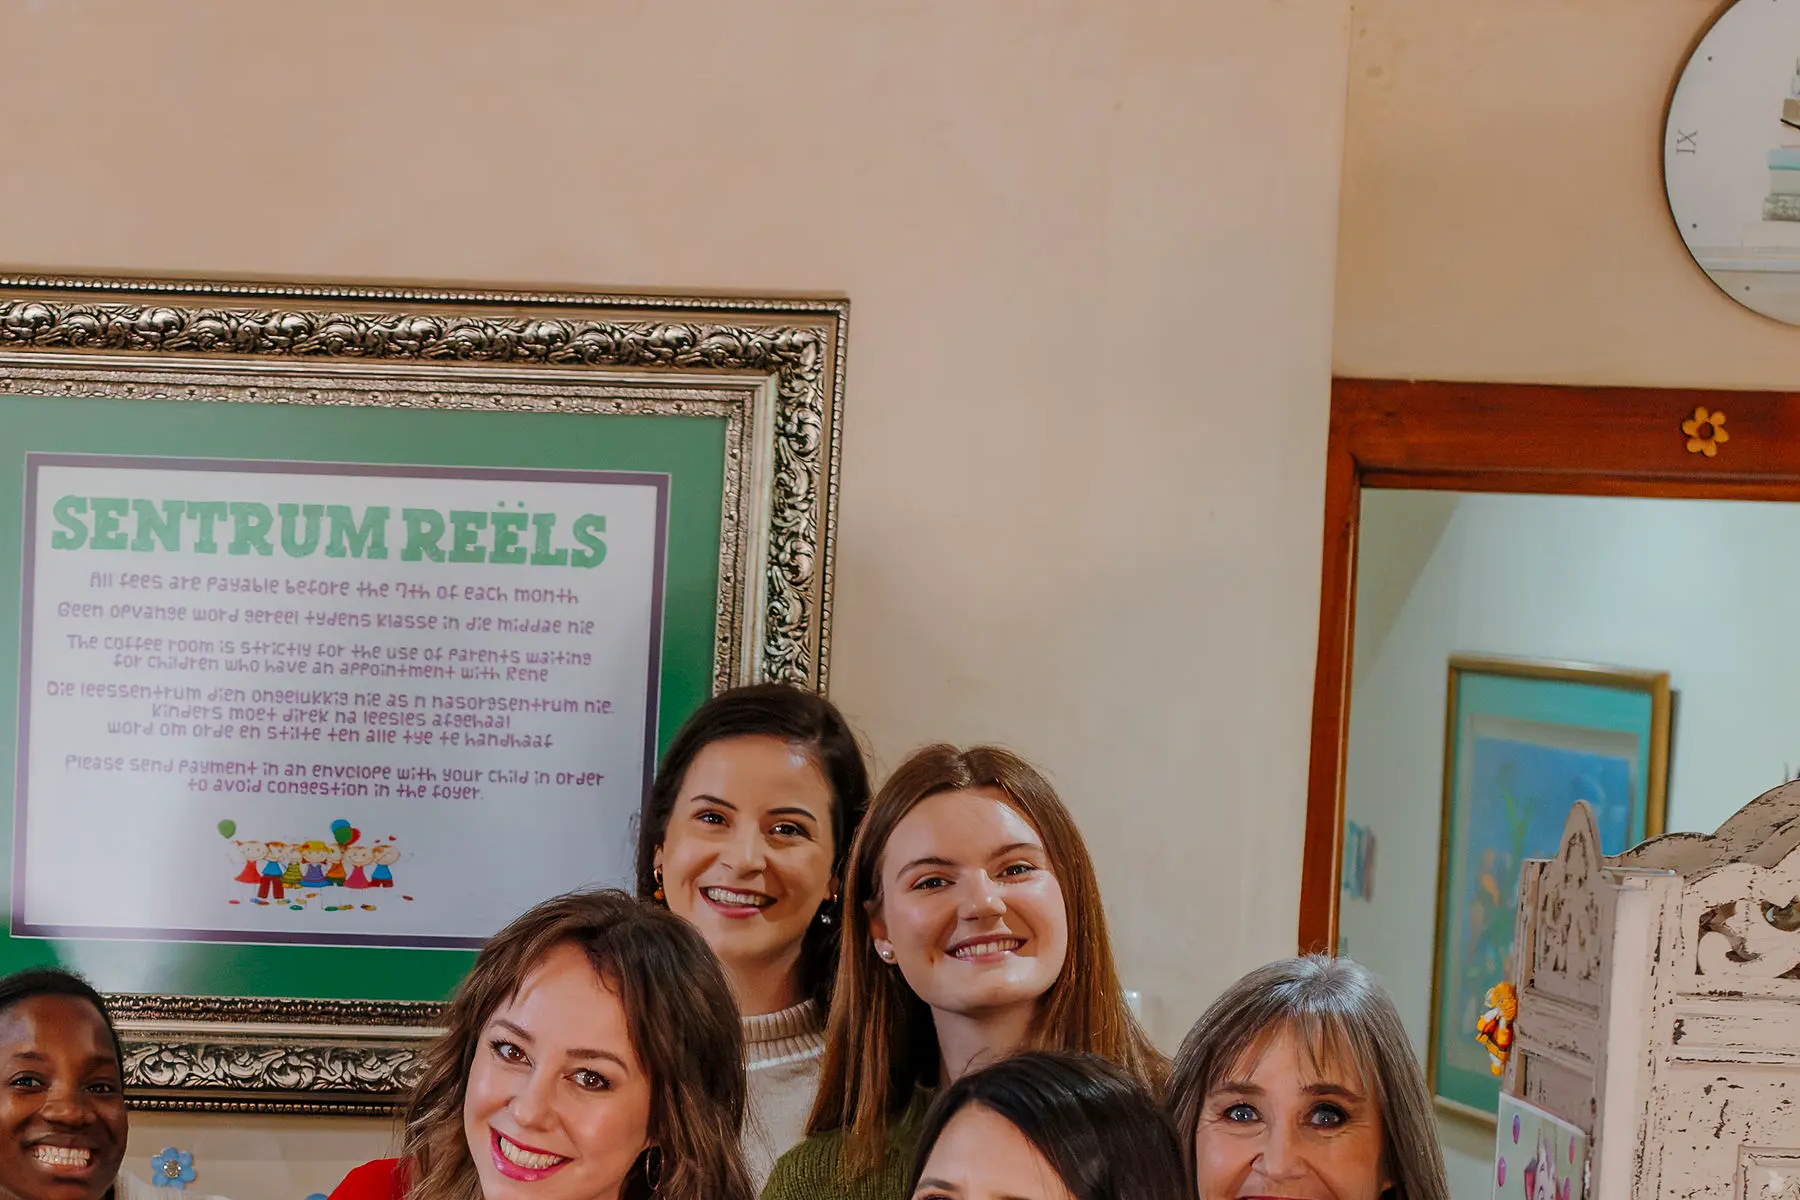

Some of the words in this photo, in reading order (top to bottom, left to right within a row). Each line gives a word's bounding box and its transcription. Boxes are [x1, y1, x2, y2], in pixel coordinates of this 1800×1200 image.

[51, 495, 390, 559] SENTRUM
[401, 500, 607, 569] REËLS
[90, 571, 112, 588] All
[119, 573, 162, 589] fees
[169, 576, 200, 590] are
[286, 579, 349, 596] before
[356, 581, 389, 597] the
[396, 582, 430, 599] 7th
[437, 585, 458, 599] of
[464, 585, 507, 601] each
[514, 587, 578, 604] month
[58, 602, 103, 618] Geen
[193, 607, 239, 622] word
[305, 610, 371, 627] tydens
[443, 615, 459, 630] in
[466, 615, 491, 631] die
[567, 619, 595, 635] nie
[66, 635, 98, 649] The
[104, 635, 162, 652] coffee
[169, 638, 214, 653] room
[220, 639, 234, 654] is
[241, 640, 311, 656] strictly
[316, 642, 344, 658] for
[351, 644, 381, 659] the
[387, 646, 418, 660] use
[424, 647, 442, 661] of
[526, 650, 591, 666] waiting
[113, 653, 141, 668] for
[225, 659, 259, 673] who
[264, 659, 307, 674] have
[312, 661, 334, 675] an
[461, 666, 500, 680] with
[47, 681, 75, 696] Die
[81, 682, 201, 700] leessentrum
[207, 687, 246, 702] dien
[355, 692, 381, 707] nie
[387, 694, 408, 708] as
[415, 695, 426, 709] n
[432, 695, 578, 713] nasorgsentrum
[229, 708, 277, 721] moet
[282, 709, 328, 724] direk
[335, 710, 356, 724] na
[363, 711, 426, 726] leesles
[432, 714, 510, 729] afgehaal
[108, 721, 153, 735] word
[160, 723, 186, 737] om
[193, 723, 233, 738] orde
[240, 725, 260, 739] en
[267, 726, 321, 741] stilte
[327, 728, 359, 742] ten
[366, 729, 397, 744] alle
[403, 730, 433, 745] tye
[439, 731, 459, 746] te
[465, 733, 554, 748] handhaaf
[66, 754, 124, 771] Please
[130, 757, 173, 773] send
[263, 761, 278, 776] in
[284, 762, 306, 777] an
[397, 766, 436, 782] with
[442, 768, 482, 783] your
[535, 771, 549, 784] in
[556, 772, 604, 786] order
[188, 778, 207, 791] to
[213, 780, 262, 793] avoid
[267, 780, 368, 797] congestion
[374, 783, 390, 797] in
[396, 783, 426, 798] the
